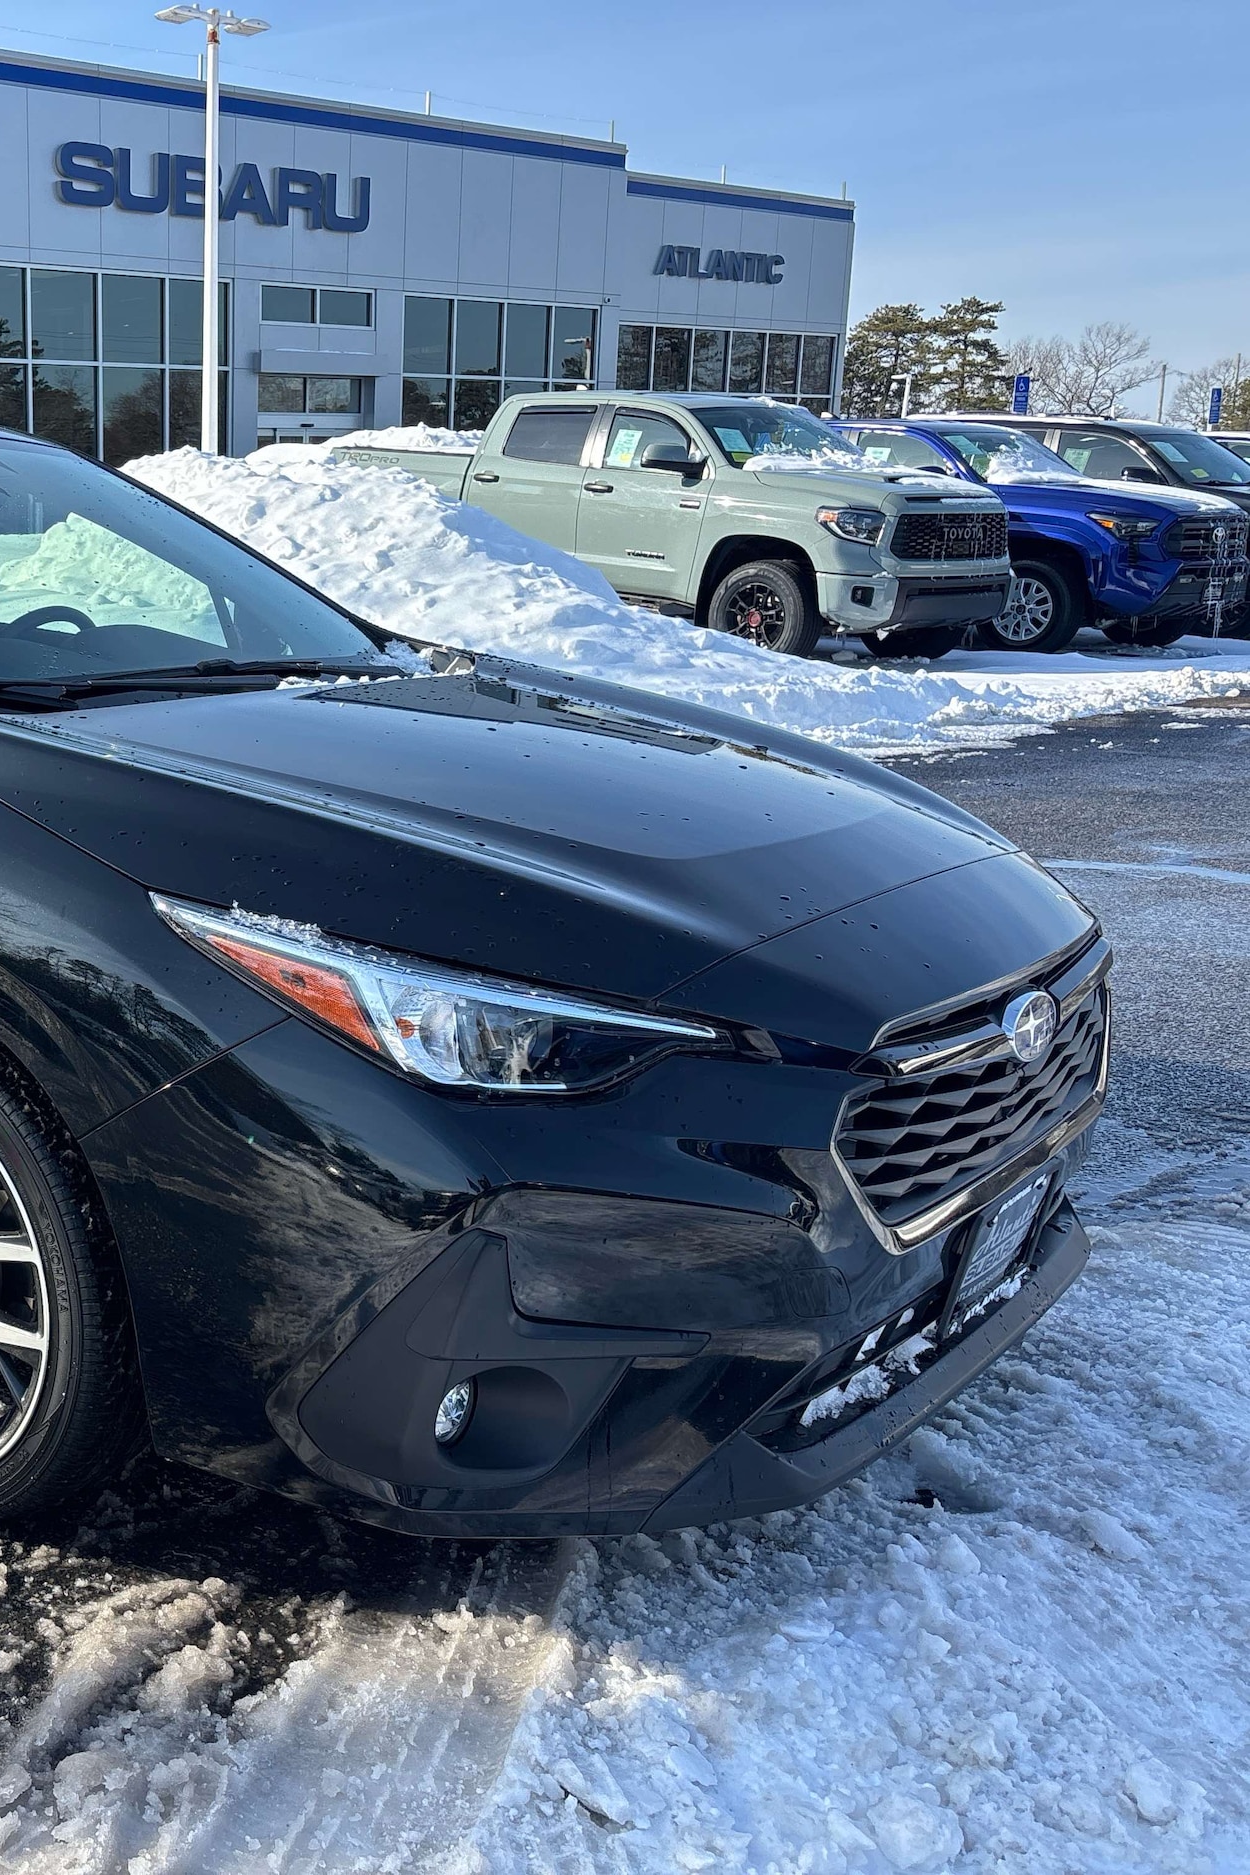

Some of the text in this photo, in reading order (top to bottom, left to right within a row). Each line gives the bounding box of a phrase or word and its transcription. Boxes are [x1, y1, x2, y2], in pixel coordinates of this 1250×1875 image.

[53, 141, 371, 232] SUBARU
[653, 245, 785, 285] ATLANTIC
[943, 527, 984, 540] TOYOTA
[41, 1222, 69, 1314] YOKOHAMA
